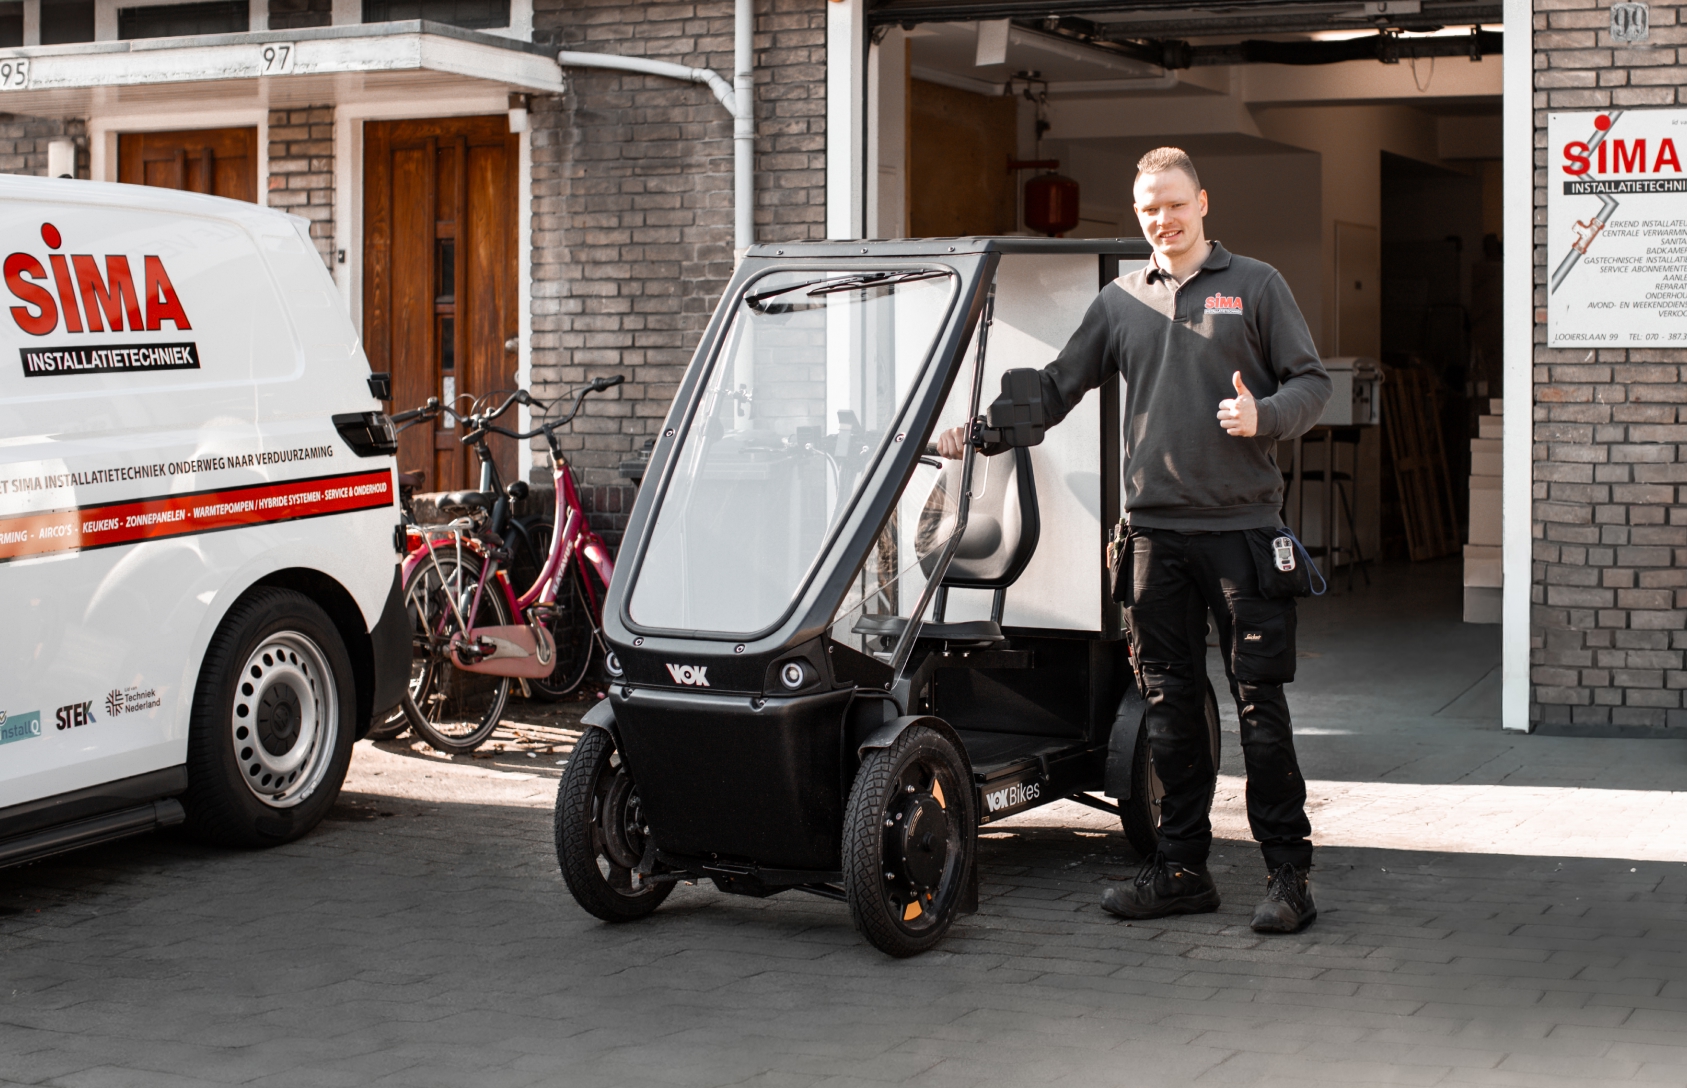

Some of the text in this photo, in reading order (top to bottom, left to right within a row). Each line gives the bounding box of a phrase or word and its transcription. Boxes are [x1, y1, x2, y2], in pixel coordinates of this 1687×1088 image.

[1614, 6, 1647, 37] 99
[263, 46, 291, 71] 97
[1, 62, 26, 86] 95
[1572, 180, 1687, 194] INSTALLATIETECHNI
[1609, 220, 1640, 228] ERKEND
[1602, 229, 1640, 237] CENTRALE
[1660, 238, 1687, 246] SANITA
[1583, 256, 1643, 265] GASTECHNISCHE
[1600, 265, 1629, 273] SERVICE
[1587, 301, 1617, 309] AVOND-
[1619, 301, 1630, 309] EN
[1555, 333, 1607, 341] LOOIERSLAAN
[1609, 333, 1619, 341] 99
[1645, 333, 1659, 341] 070
[27, 347, 193, 372] INSTALLATIETECHNIEK
[0, 445, 333, 494] T SIMA INSTALLATIETECHNIEK ONDERWEG NAAR VERDUURZAMING
[82, 518, 119, 533] KEUKENS
[125, 509, 186, 528] ZONNEPANELEN
[193, 500, 254, 518] WARMTEPOMPEN
[259, 495, 288, 509] HYBRIDE
[289, 491, 321, 506] SYSTEMEN
[325, 486, 348, 500] SERVICE
[354, 482, 387, 496] ONDERHOUD
[665, 662, 711, 687] VOK
[125, 688, 156, 702] Techniek
[125, 697, 161, 713] Nederland
[56, 700, 97, 731] STEK
[986, 782, 1040, 813] VOK Bikes
